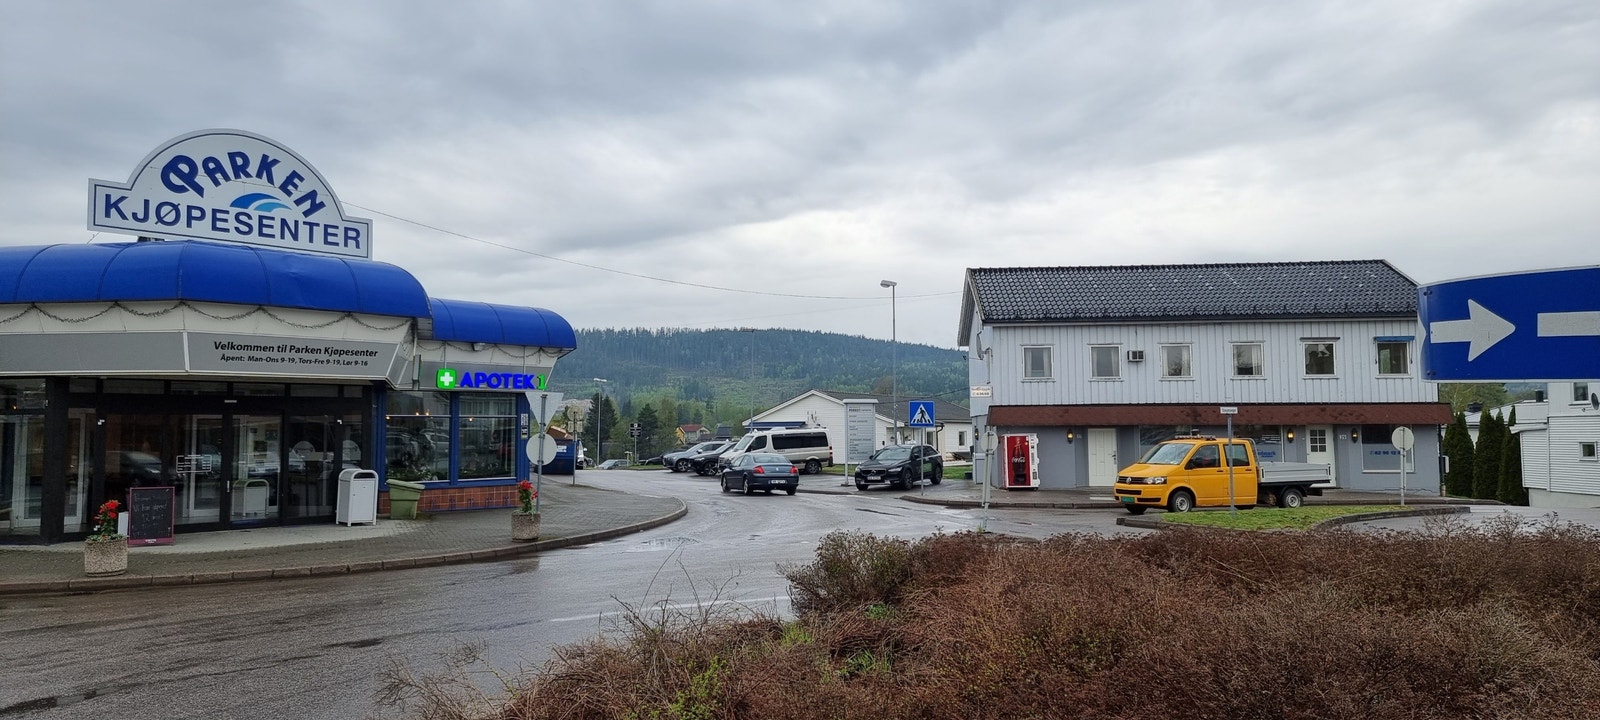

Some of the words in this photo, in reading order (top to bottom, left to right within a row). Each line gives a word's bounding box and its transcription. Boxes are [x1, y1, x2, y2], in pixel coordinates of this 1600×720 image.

[160, 151, 327, 219] PARKEN
[104, 193, 362, 250] KJØPESENTER
[214, 341, 274, 353] Velkommen
[276, 345, 287, 353] til
[289, 345, 321, 355] Parken
[323, 347, 378, 358] Kjøpesenter
[220, 354, 245, 363] Åpent:
[247, 355, 279, 363] Man-Ons
[280, 357, 297, 365] 9-19,
[460, 371, 536, 389] APOTEK
[537, 373, 547, 390] 1
